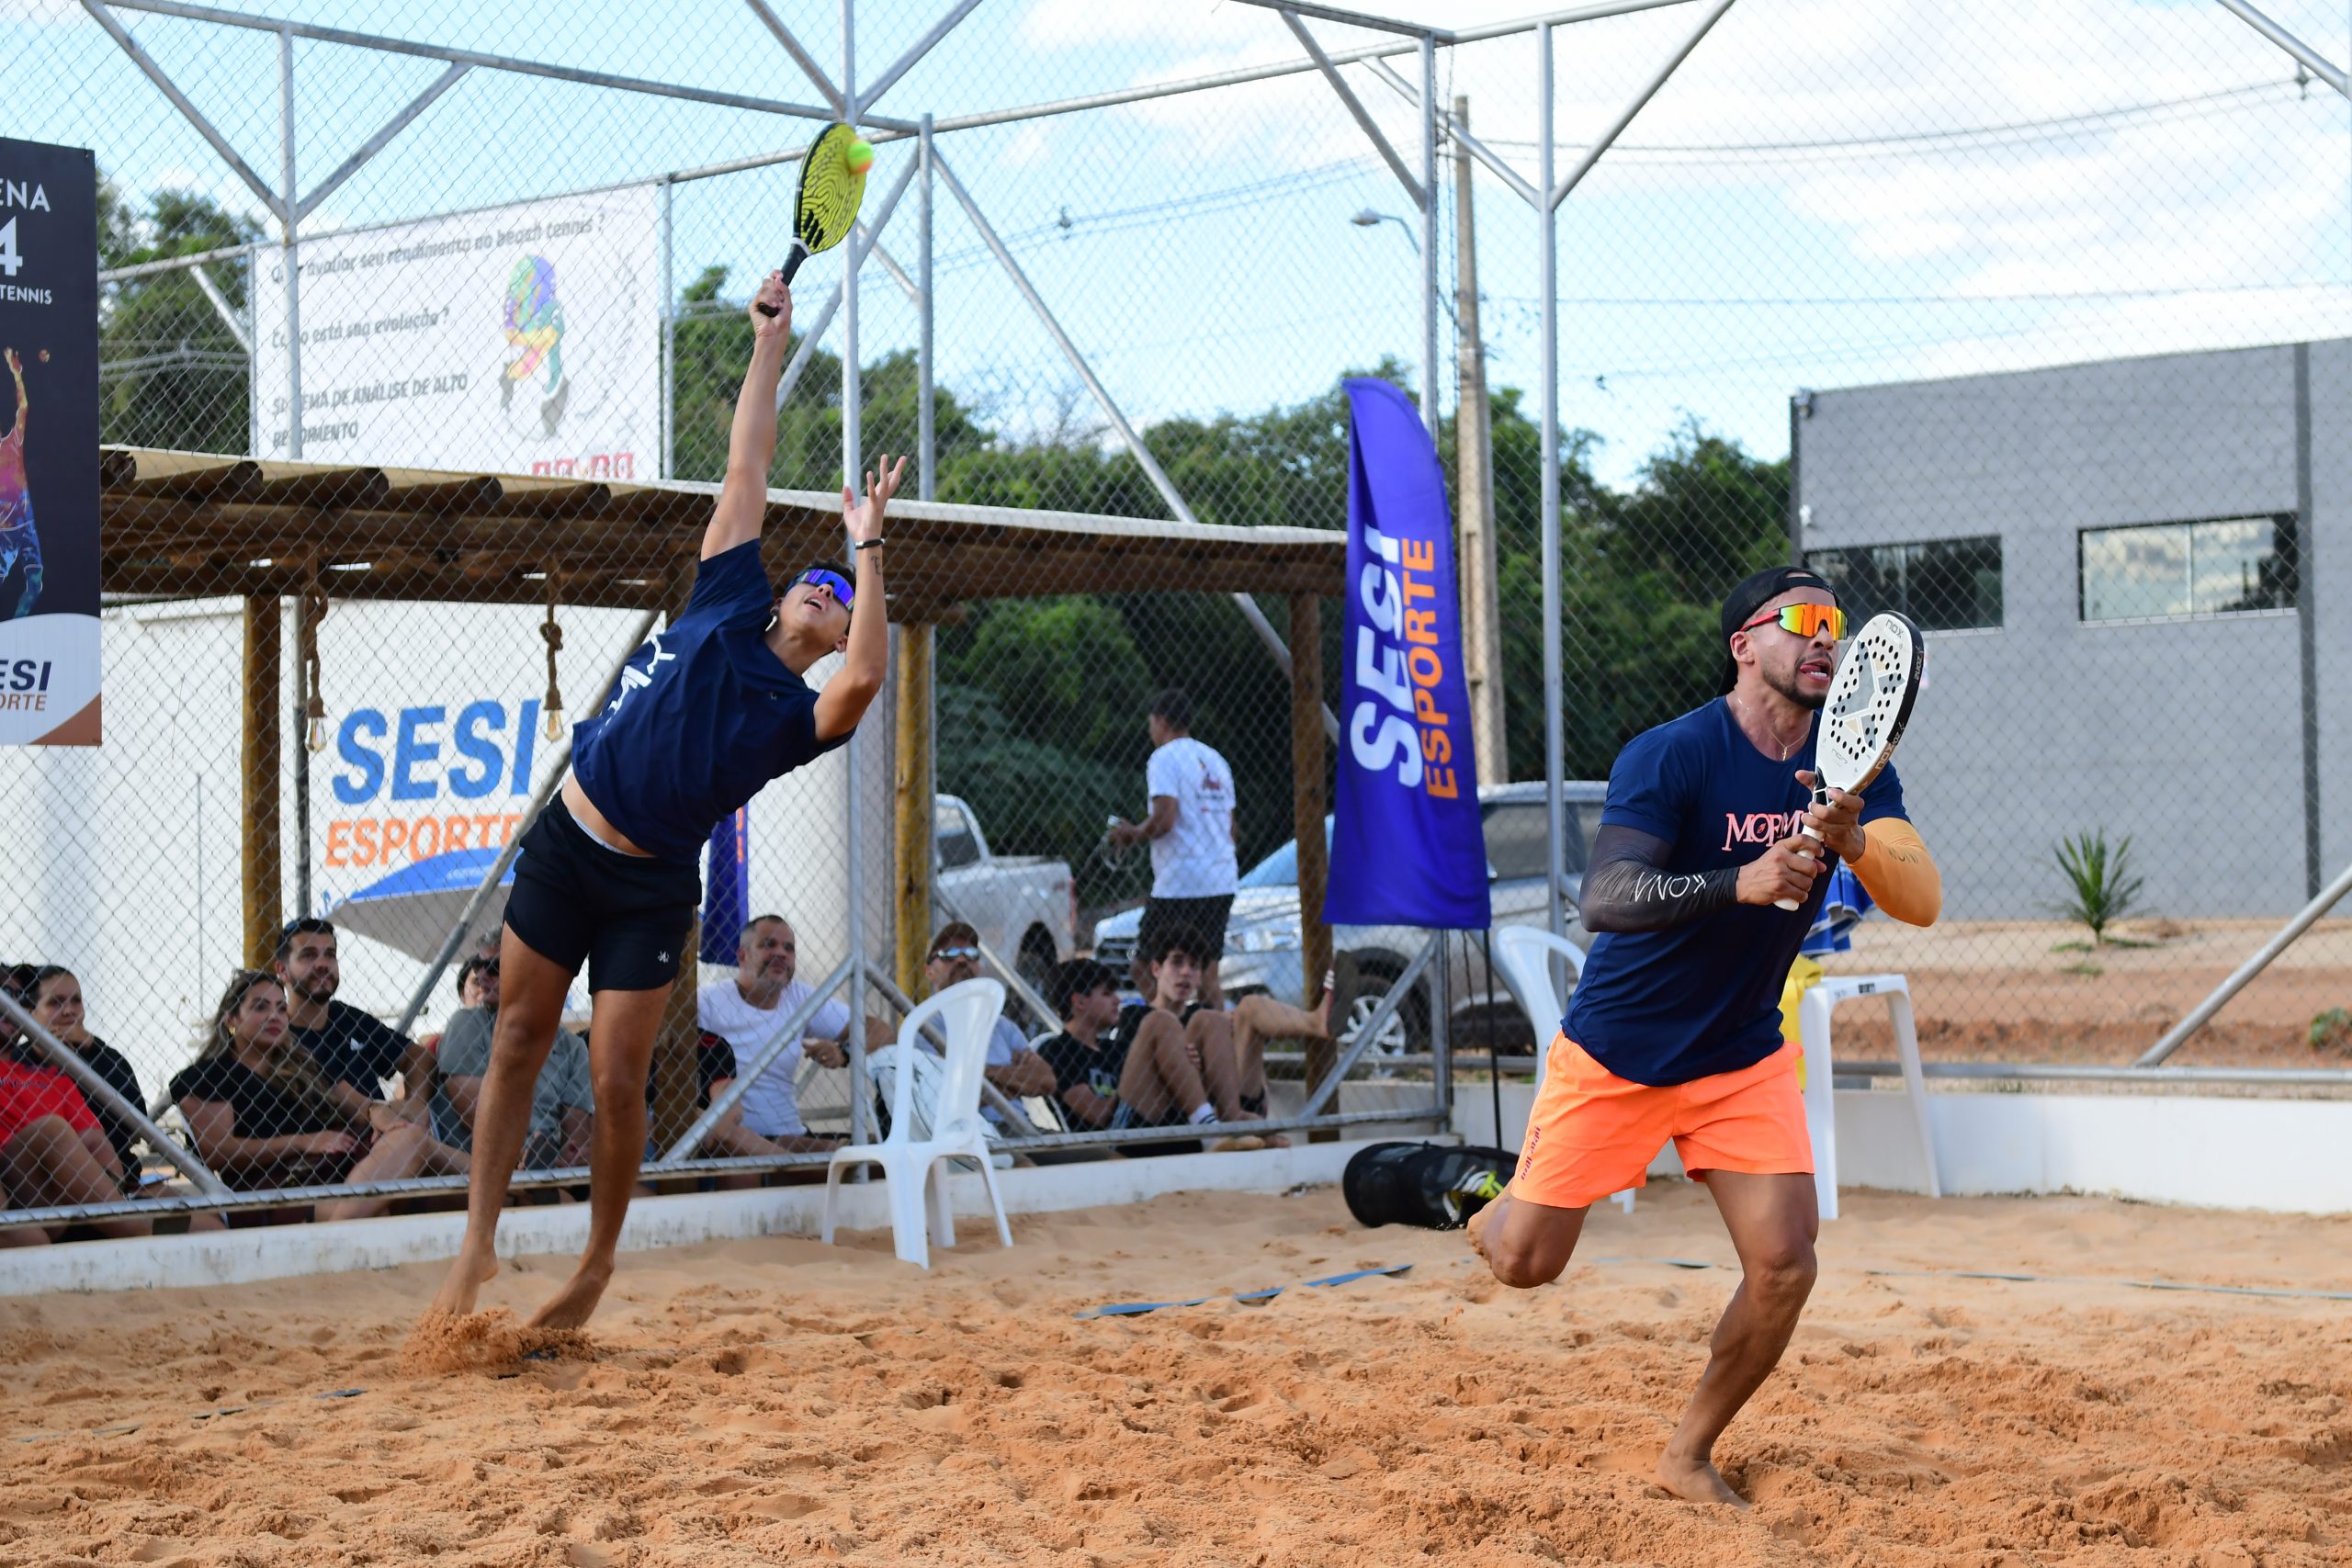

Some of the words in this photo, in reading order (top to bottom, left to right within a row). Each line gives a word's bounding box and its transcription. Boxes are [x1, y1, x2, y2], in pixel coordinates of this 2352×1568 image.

[0, 178, 51, 212] NA
[307, 254, 356, 276] avaliar
[360, 252, 385, 269] seu
[387, 237, 471, 265] rendimento
[474, 233, 493, 251] no
[497, 219, 543, 248] beach
[547, 212, 594, 240] tennis
[312, 320, 343, 344] está
[346, 321, 370, 338] sua
[374, 307, 439, 334] evolução
[273, 390, 329, 415] SIEMA
[332, 388, 349, 409] DE
[351, 378, 409, 406] ANÁLISE
[413, 377, 430, 397] DE
[433, 373, 468, 394] ALTO
[1350, 523, 1423, 788] SESI
[1402, 538, 1459, 799] ESPORTE
[332, 699, 541, 806] SESI
